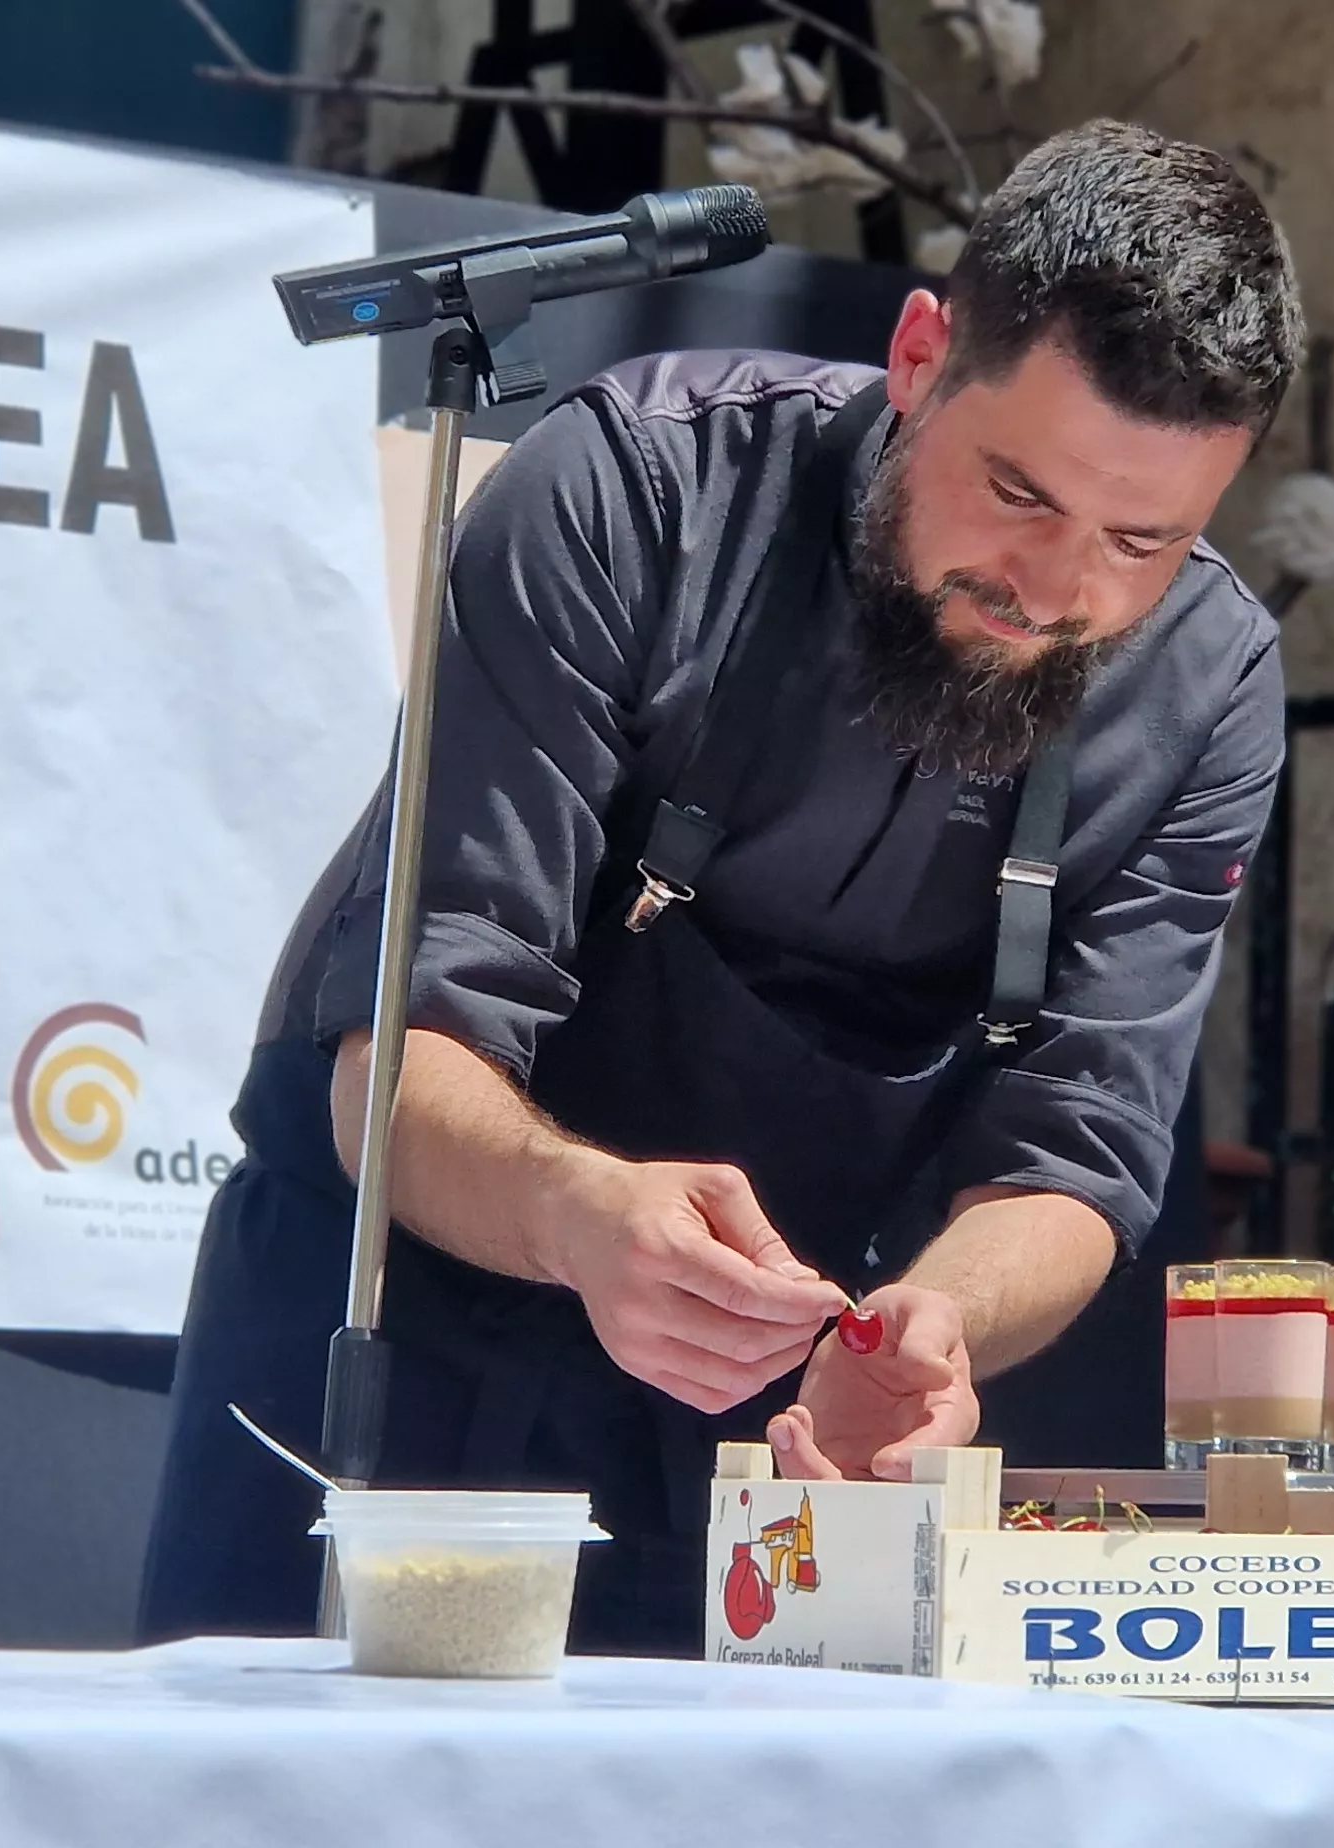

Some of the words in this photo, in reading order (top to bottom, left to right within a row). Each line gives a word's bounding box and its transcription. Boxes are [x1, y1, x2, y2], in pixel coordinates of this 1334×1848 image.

[1149, 1556, 1322, 1573] COCEBO
[1002, 1580, 1196, 1596] SOCIEDAD
[1085, 1672, 1116, 1685] 639
[1121, 1672, 1140, 1685] 61
[1146, 1672, 1165, 1685] 31
[1171, 1672, 1190, 1685] 24
[1206, 1672, 1237, 1684] 639
[1241, 1672, 1260, 1684] 61
[1267, 1672, 1284, 1684] 31
[1290, 1671, 1310, 1683] 54
